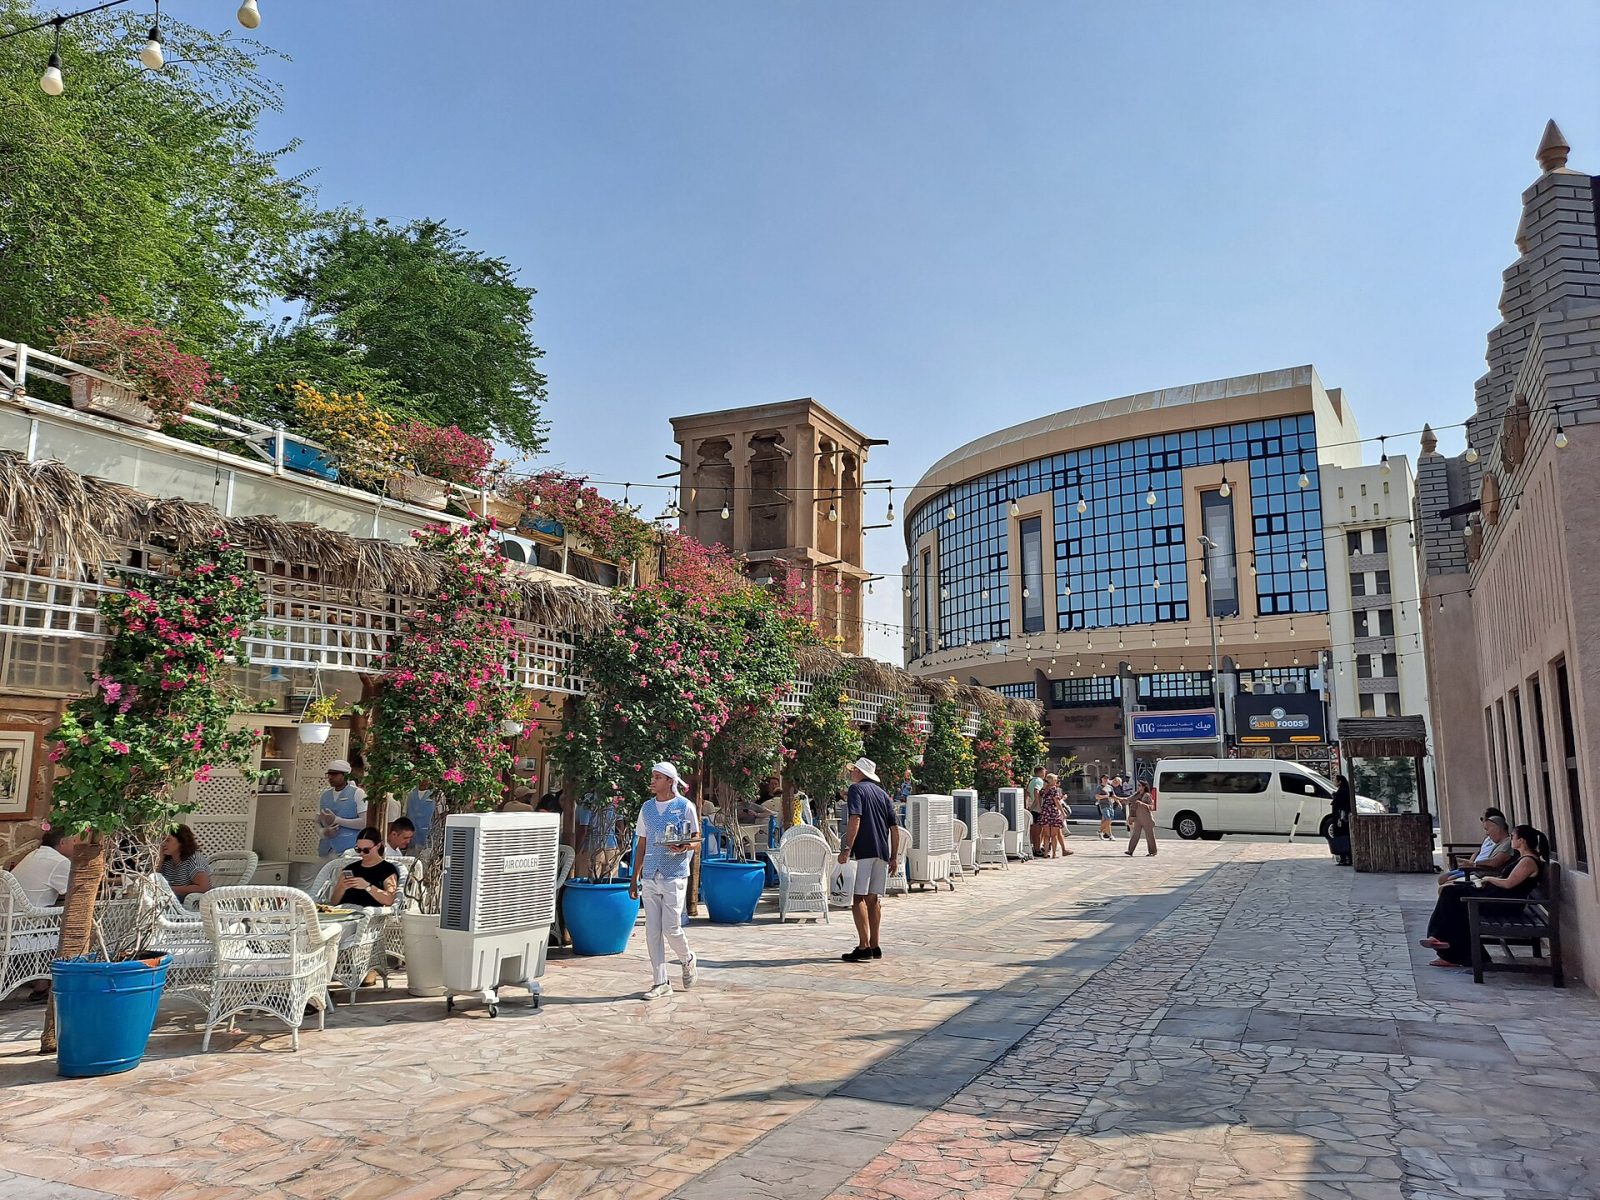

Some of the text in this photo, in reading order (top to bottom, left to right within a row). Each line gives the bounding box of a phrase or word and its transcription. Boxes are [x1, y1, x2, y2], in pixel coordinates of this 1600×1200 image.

[1136, 723, 1155, 733] MIG
[1195, 721, 1212, 731] ميك
[1277, 720, 1304, 728] FOODS
